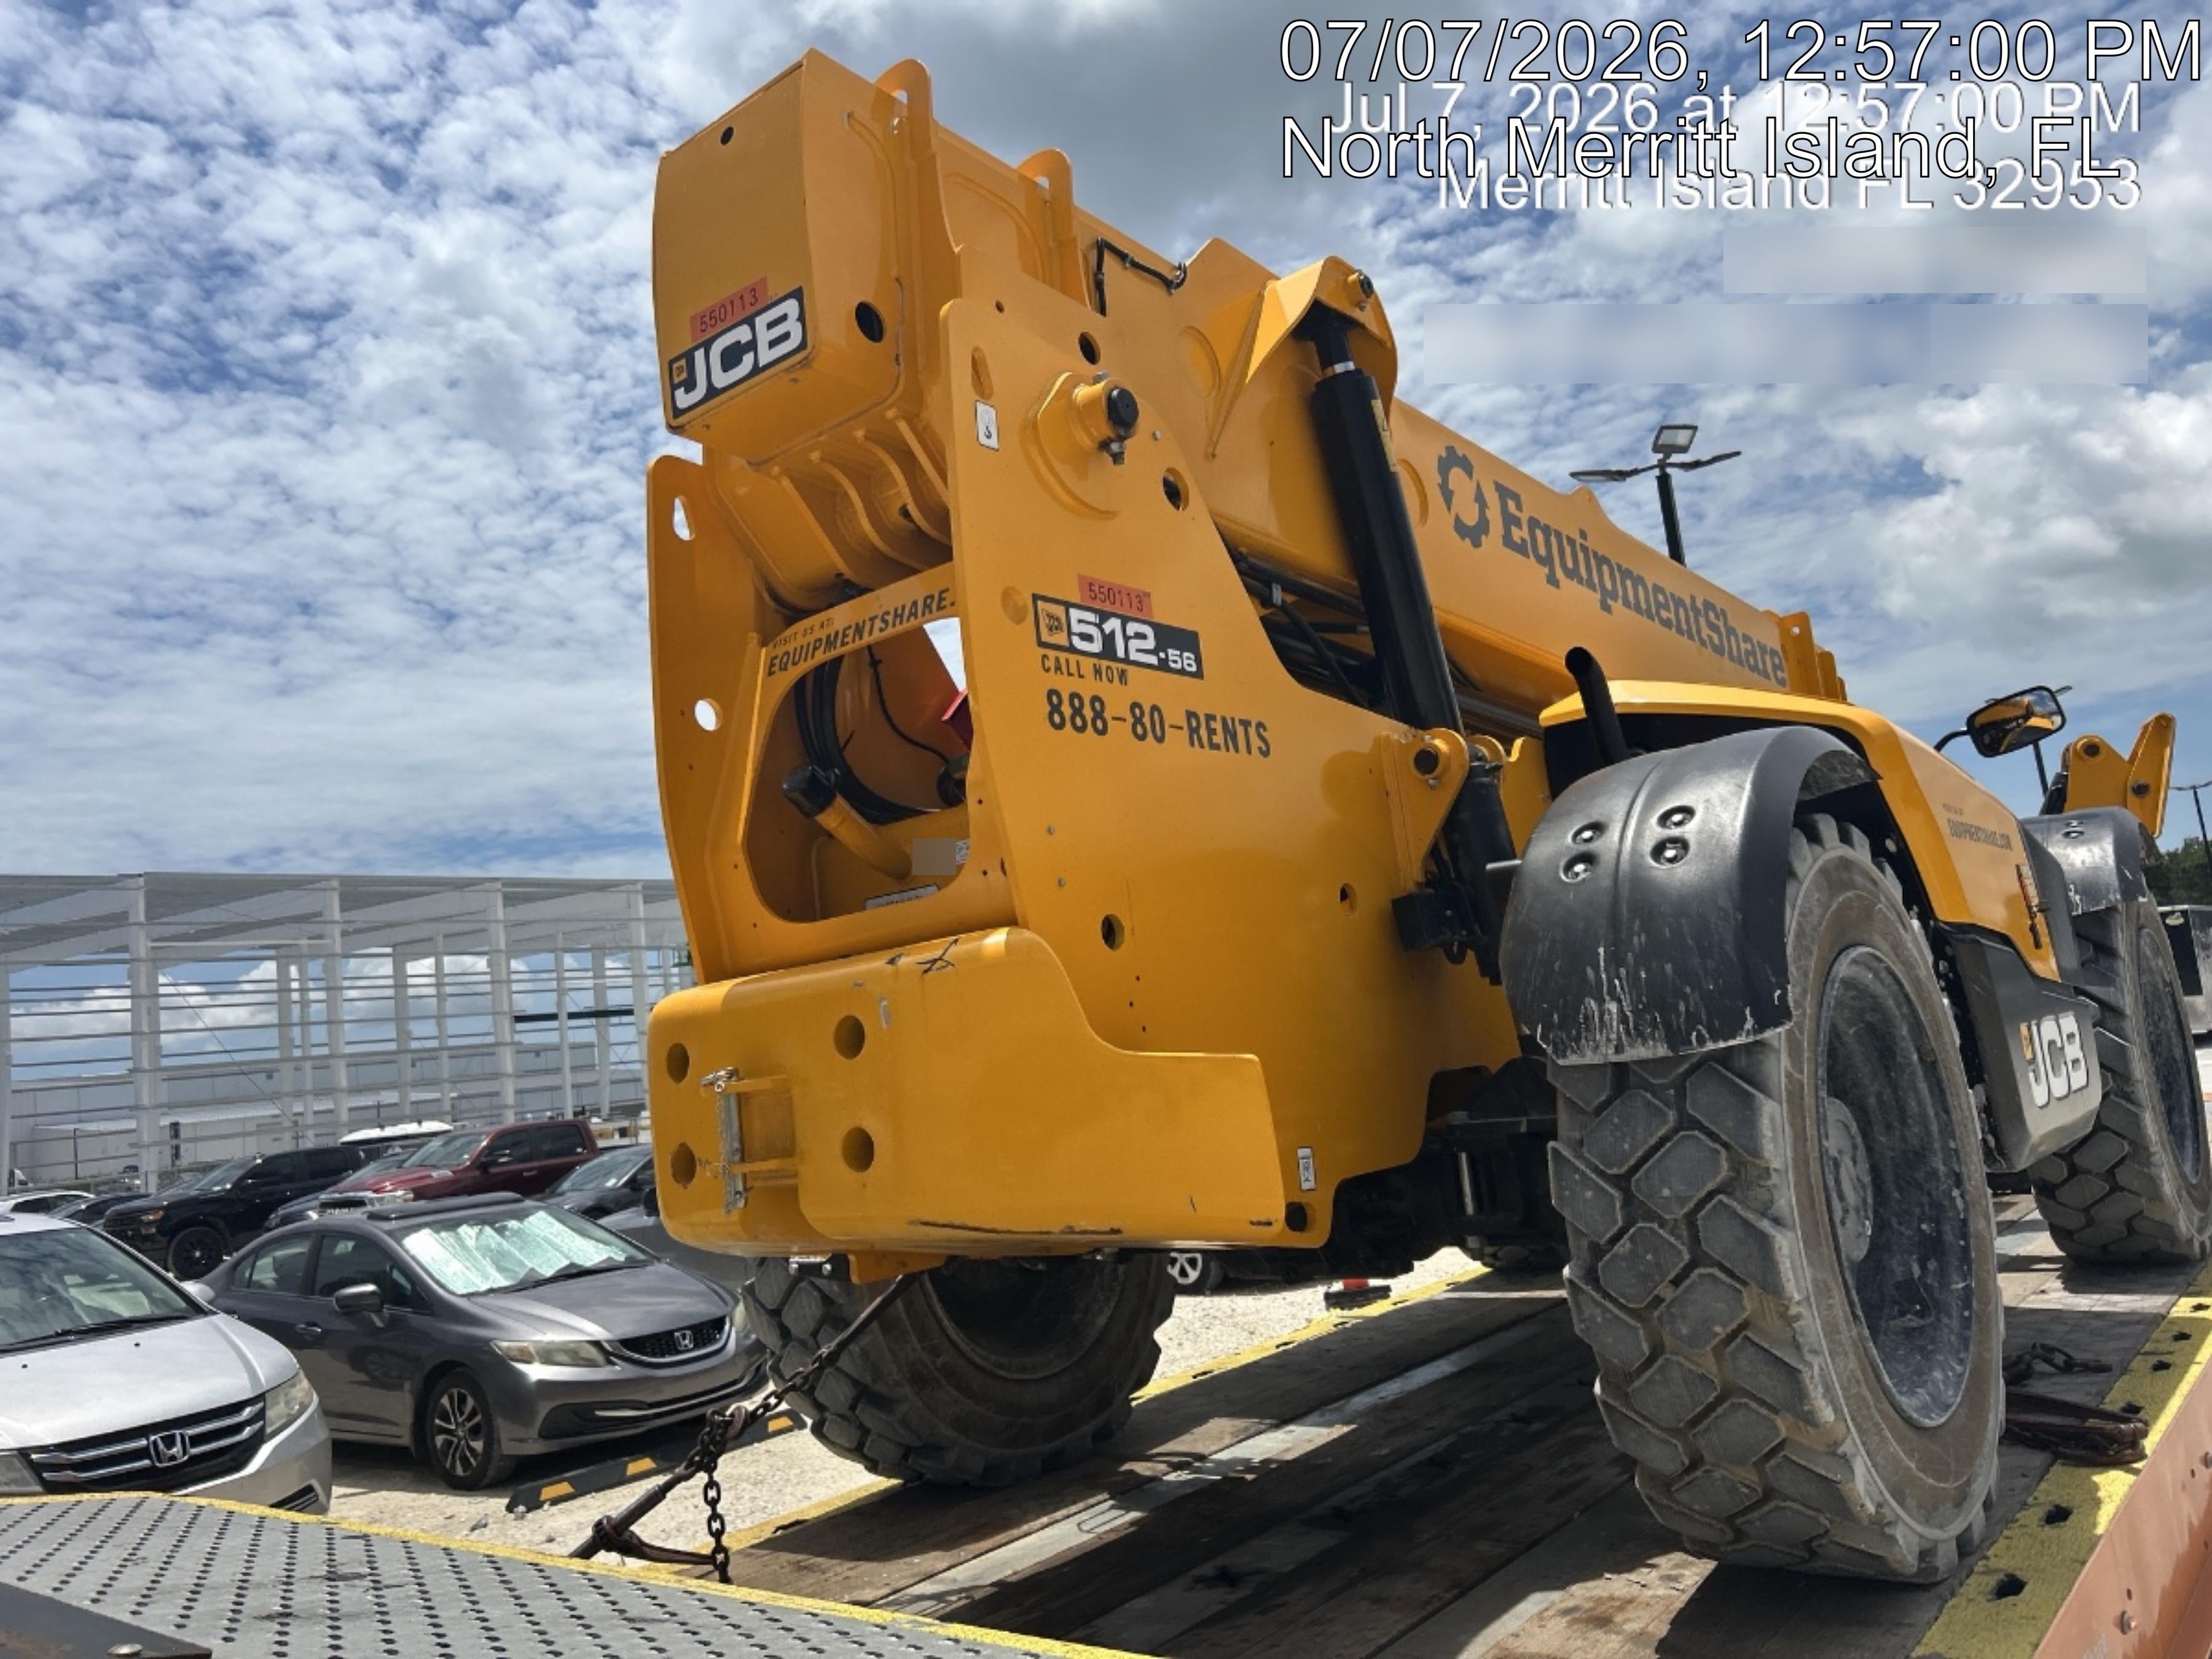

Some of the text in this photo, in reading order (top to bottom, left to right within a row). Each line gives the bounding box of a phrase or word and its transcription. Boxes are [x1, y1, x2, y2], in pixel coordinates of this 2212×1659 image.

[700, 287, 759, 333] 550113
[674, 297, 803, 410] JCB
[1088, 582, 1144, 613] 550113
[1493, 480, 1788, 689] EquipmentShare
[1041, 654, 1129, 686] CALL NOW
[1046, 688, 1271, 758] 888-80-RENTS
[2030, 1011, 2089, 1108] JCB
